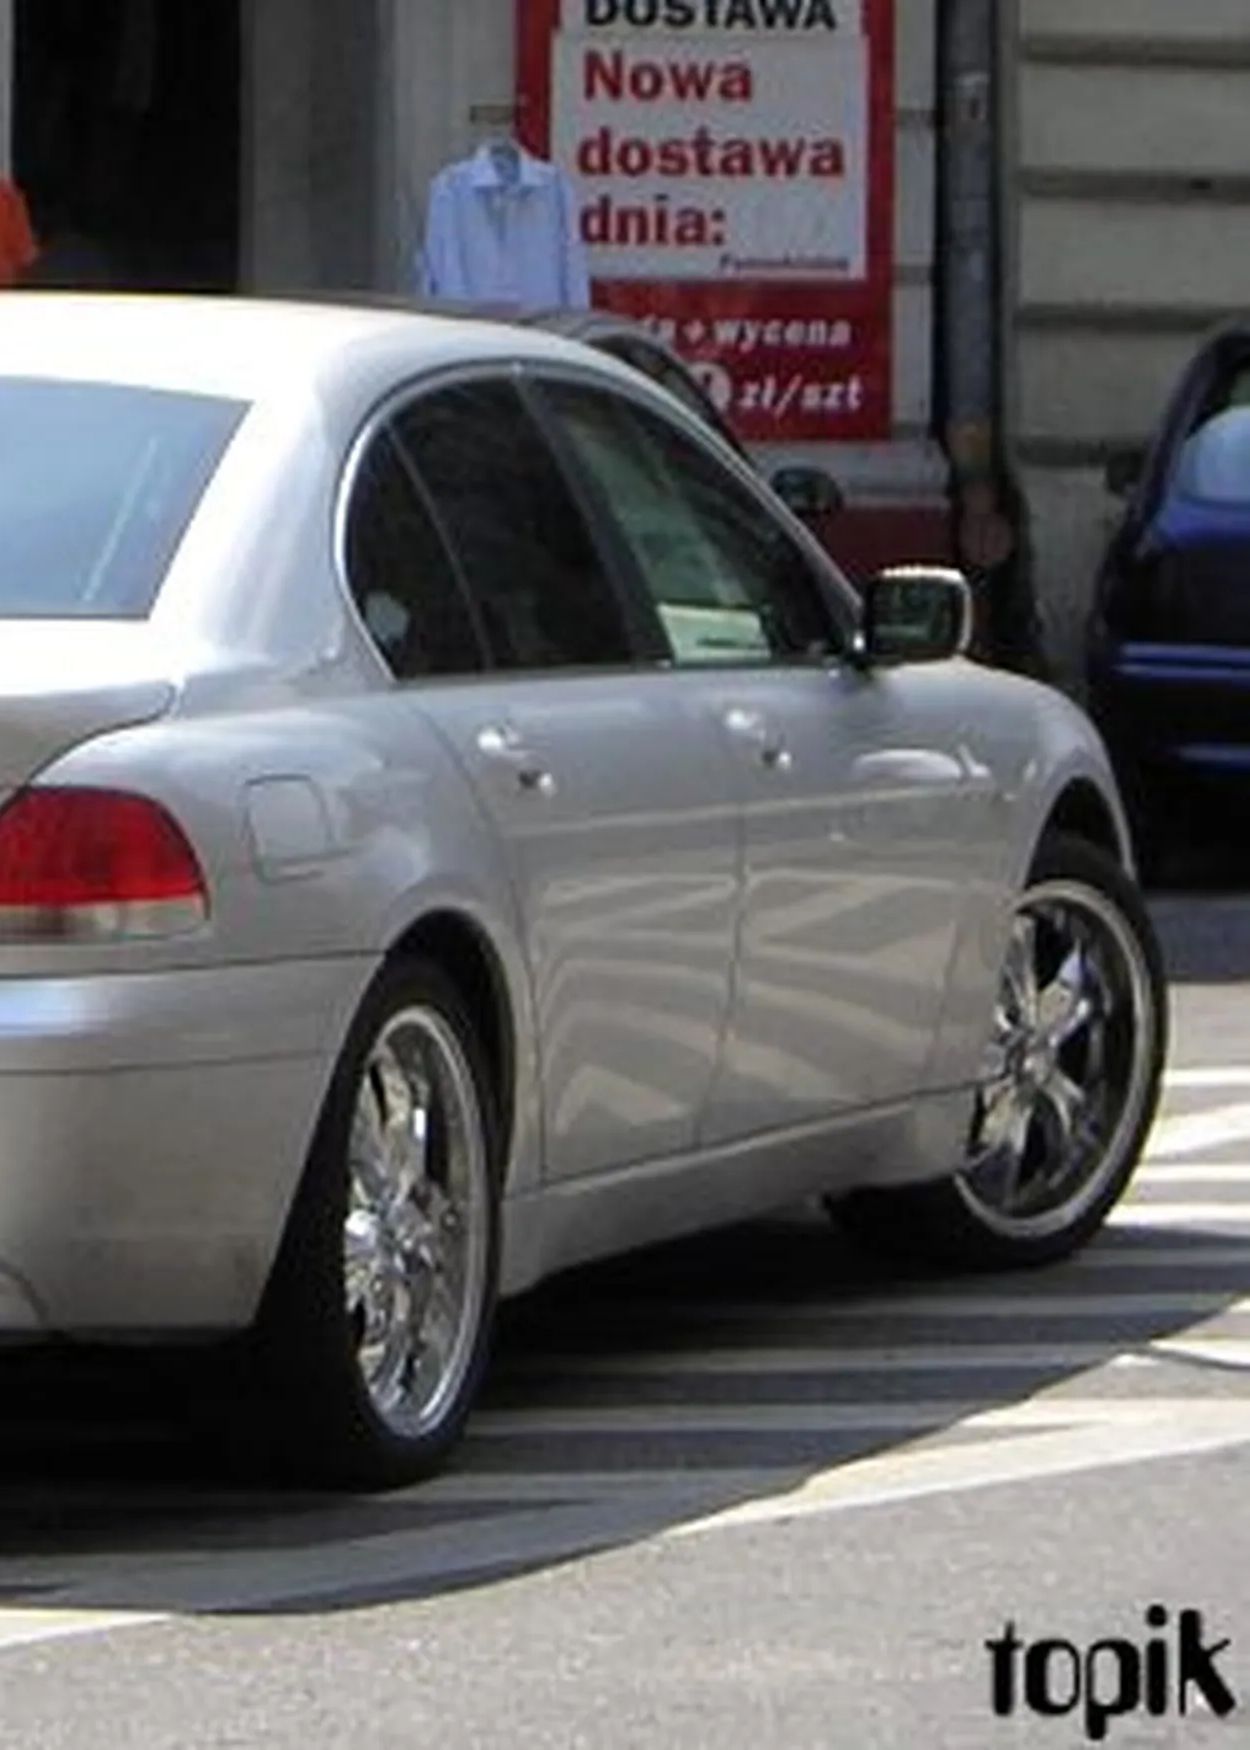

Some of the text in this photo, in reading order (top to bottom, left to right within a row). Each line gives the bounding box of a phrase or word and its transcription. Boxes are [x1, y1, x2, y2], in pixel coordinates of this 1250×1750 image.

[585, 0, 837, 30] DOSTAWA
[584, 50, 753, 101] Nowa
[577, 125, 845, 177] dostawa
[579, 193, 724, 246] dnia:
[713, 318, 851, 352] wycena
